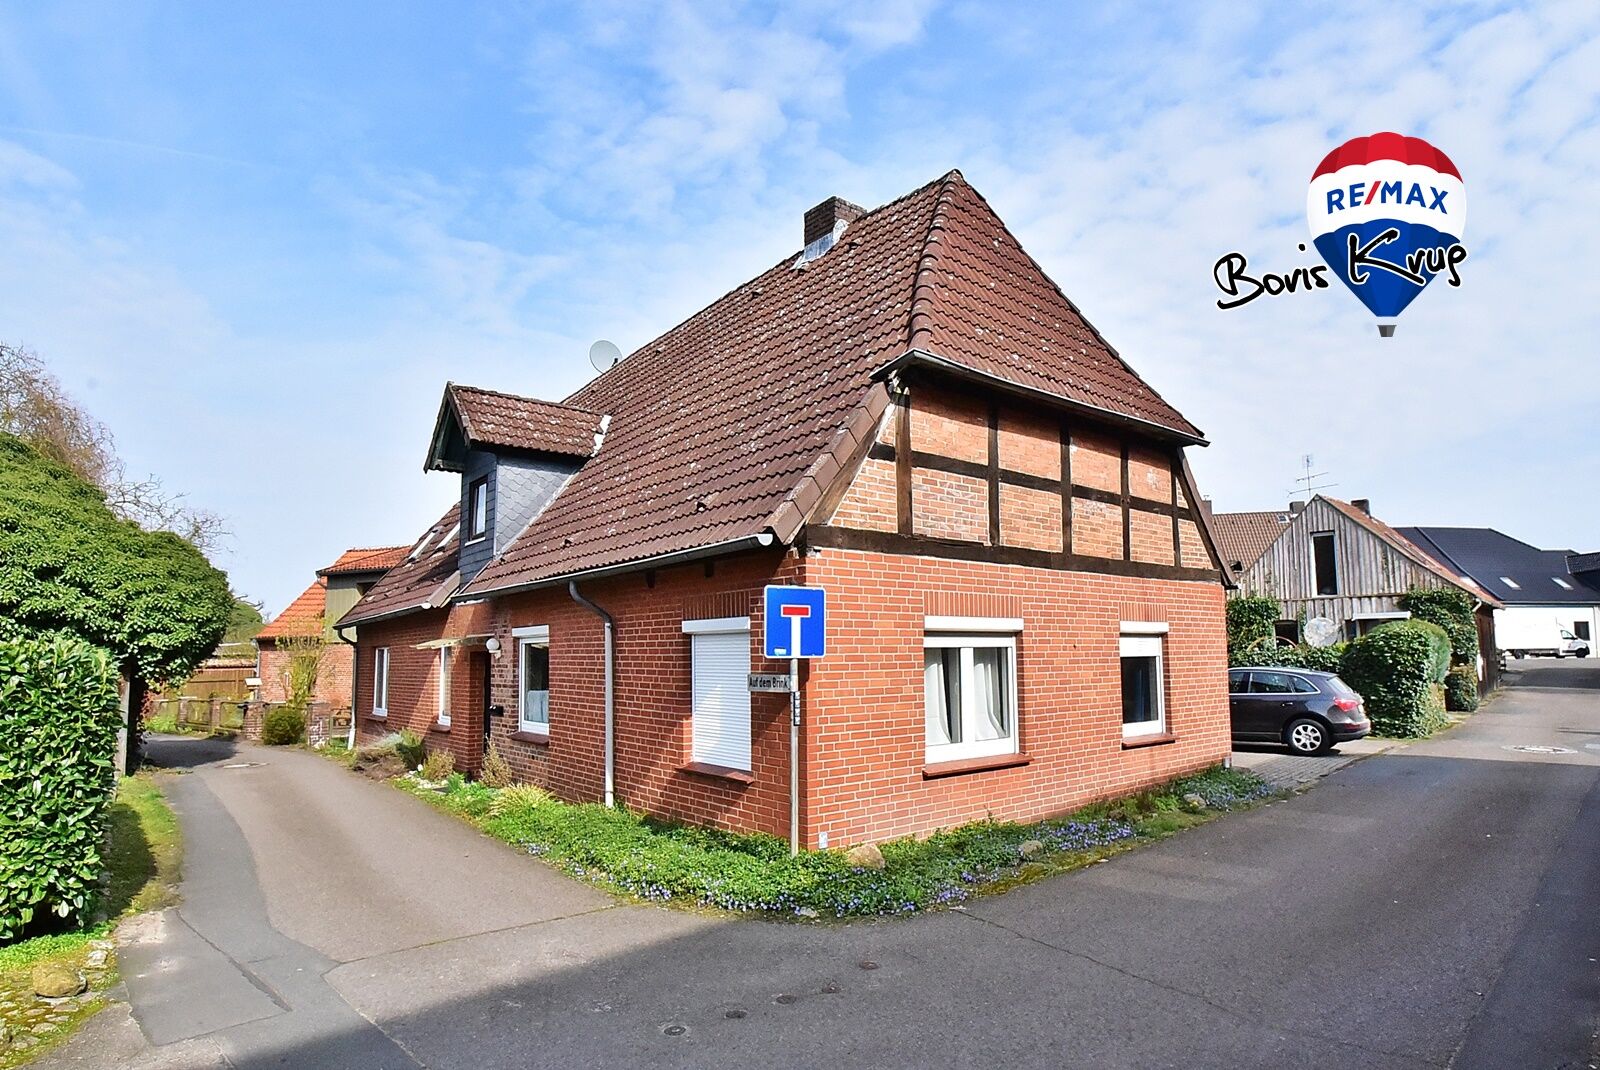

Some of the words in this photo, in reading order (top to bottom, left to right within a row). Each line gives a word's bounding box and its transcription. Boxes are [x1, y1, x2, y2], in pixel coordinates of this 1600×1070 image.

[749, 676, 758, 688] Auf
[759, 676, 771, 688] dem
[772, 676, 788, 688] Brink
